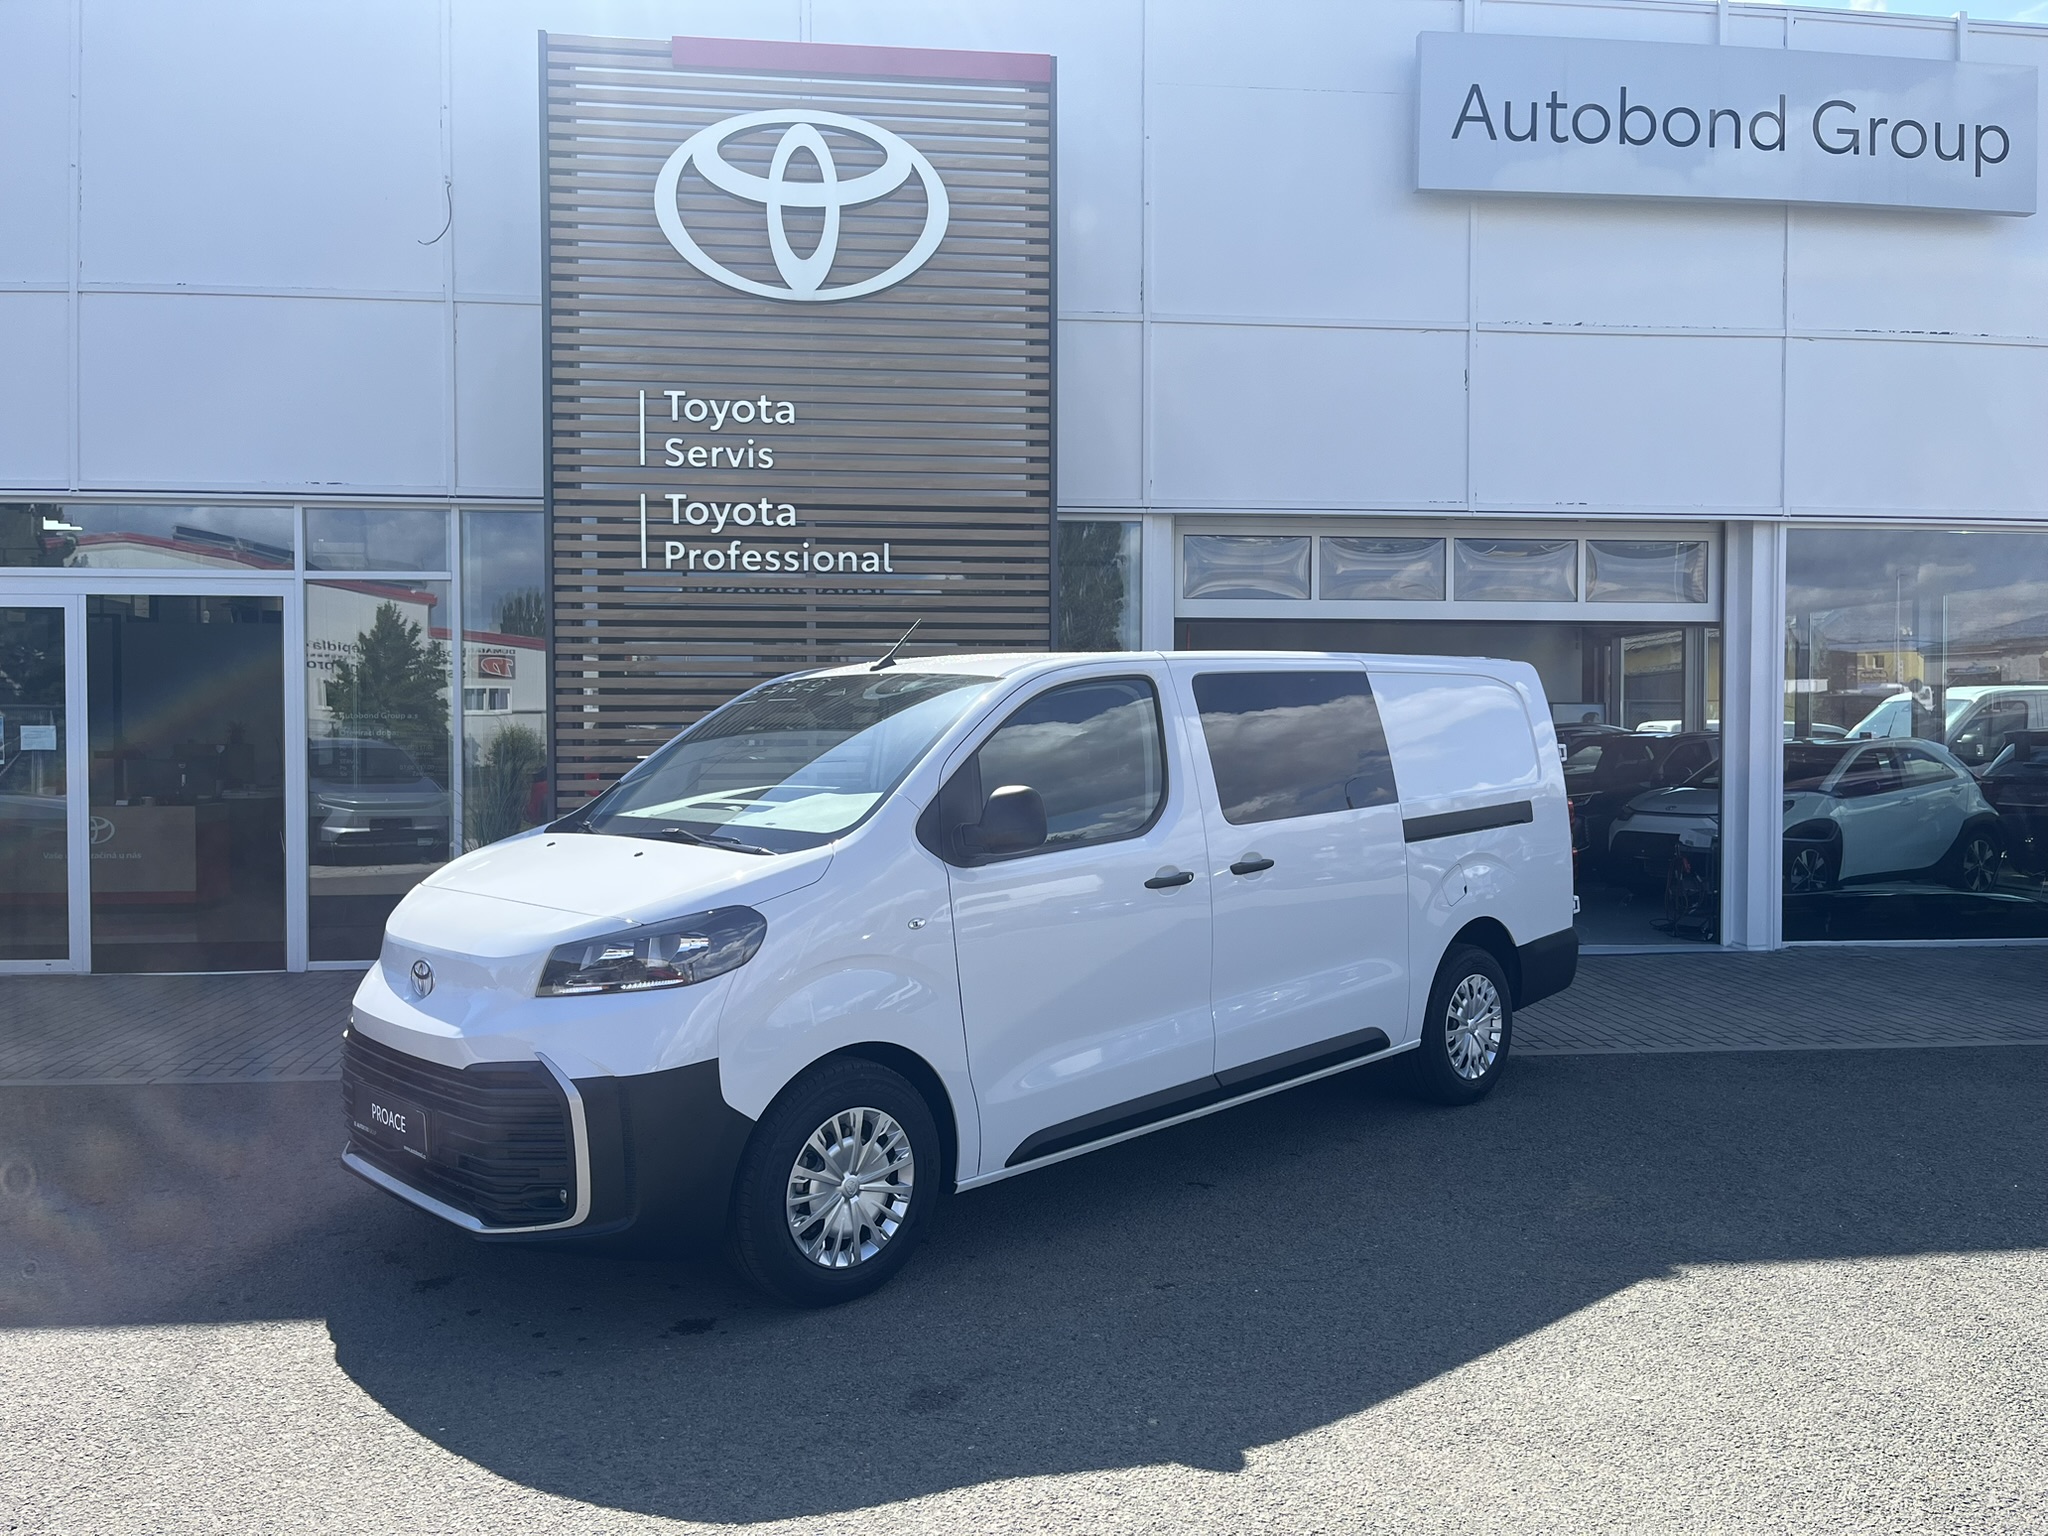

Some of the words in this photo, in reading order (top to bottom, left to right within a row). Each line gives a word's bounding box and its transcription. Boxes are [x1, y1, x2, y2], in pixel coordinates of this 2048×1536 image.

[1451, 83, 1787, 152] Autobond
[1812, 99, 2011, 178] Group
[663, 390, 796, 431] Toyota
[664, 438, 774, 469] Servis
[664, 493, 797, 534] Toyota
[665, 540, 893, 573] Professional
[381, 711, 406, 721] Group
[371, 1102, 406, 1133] PROACE
